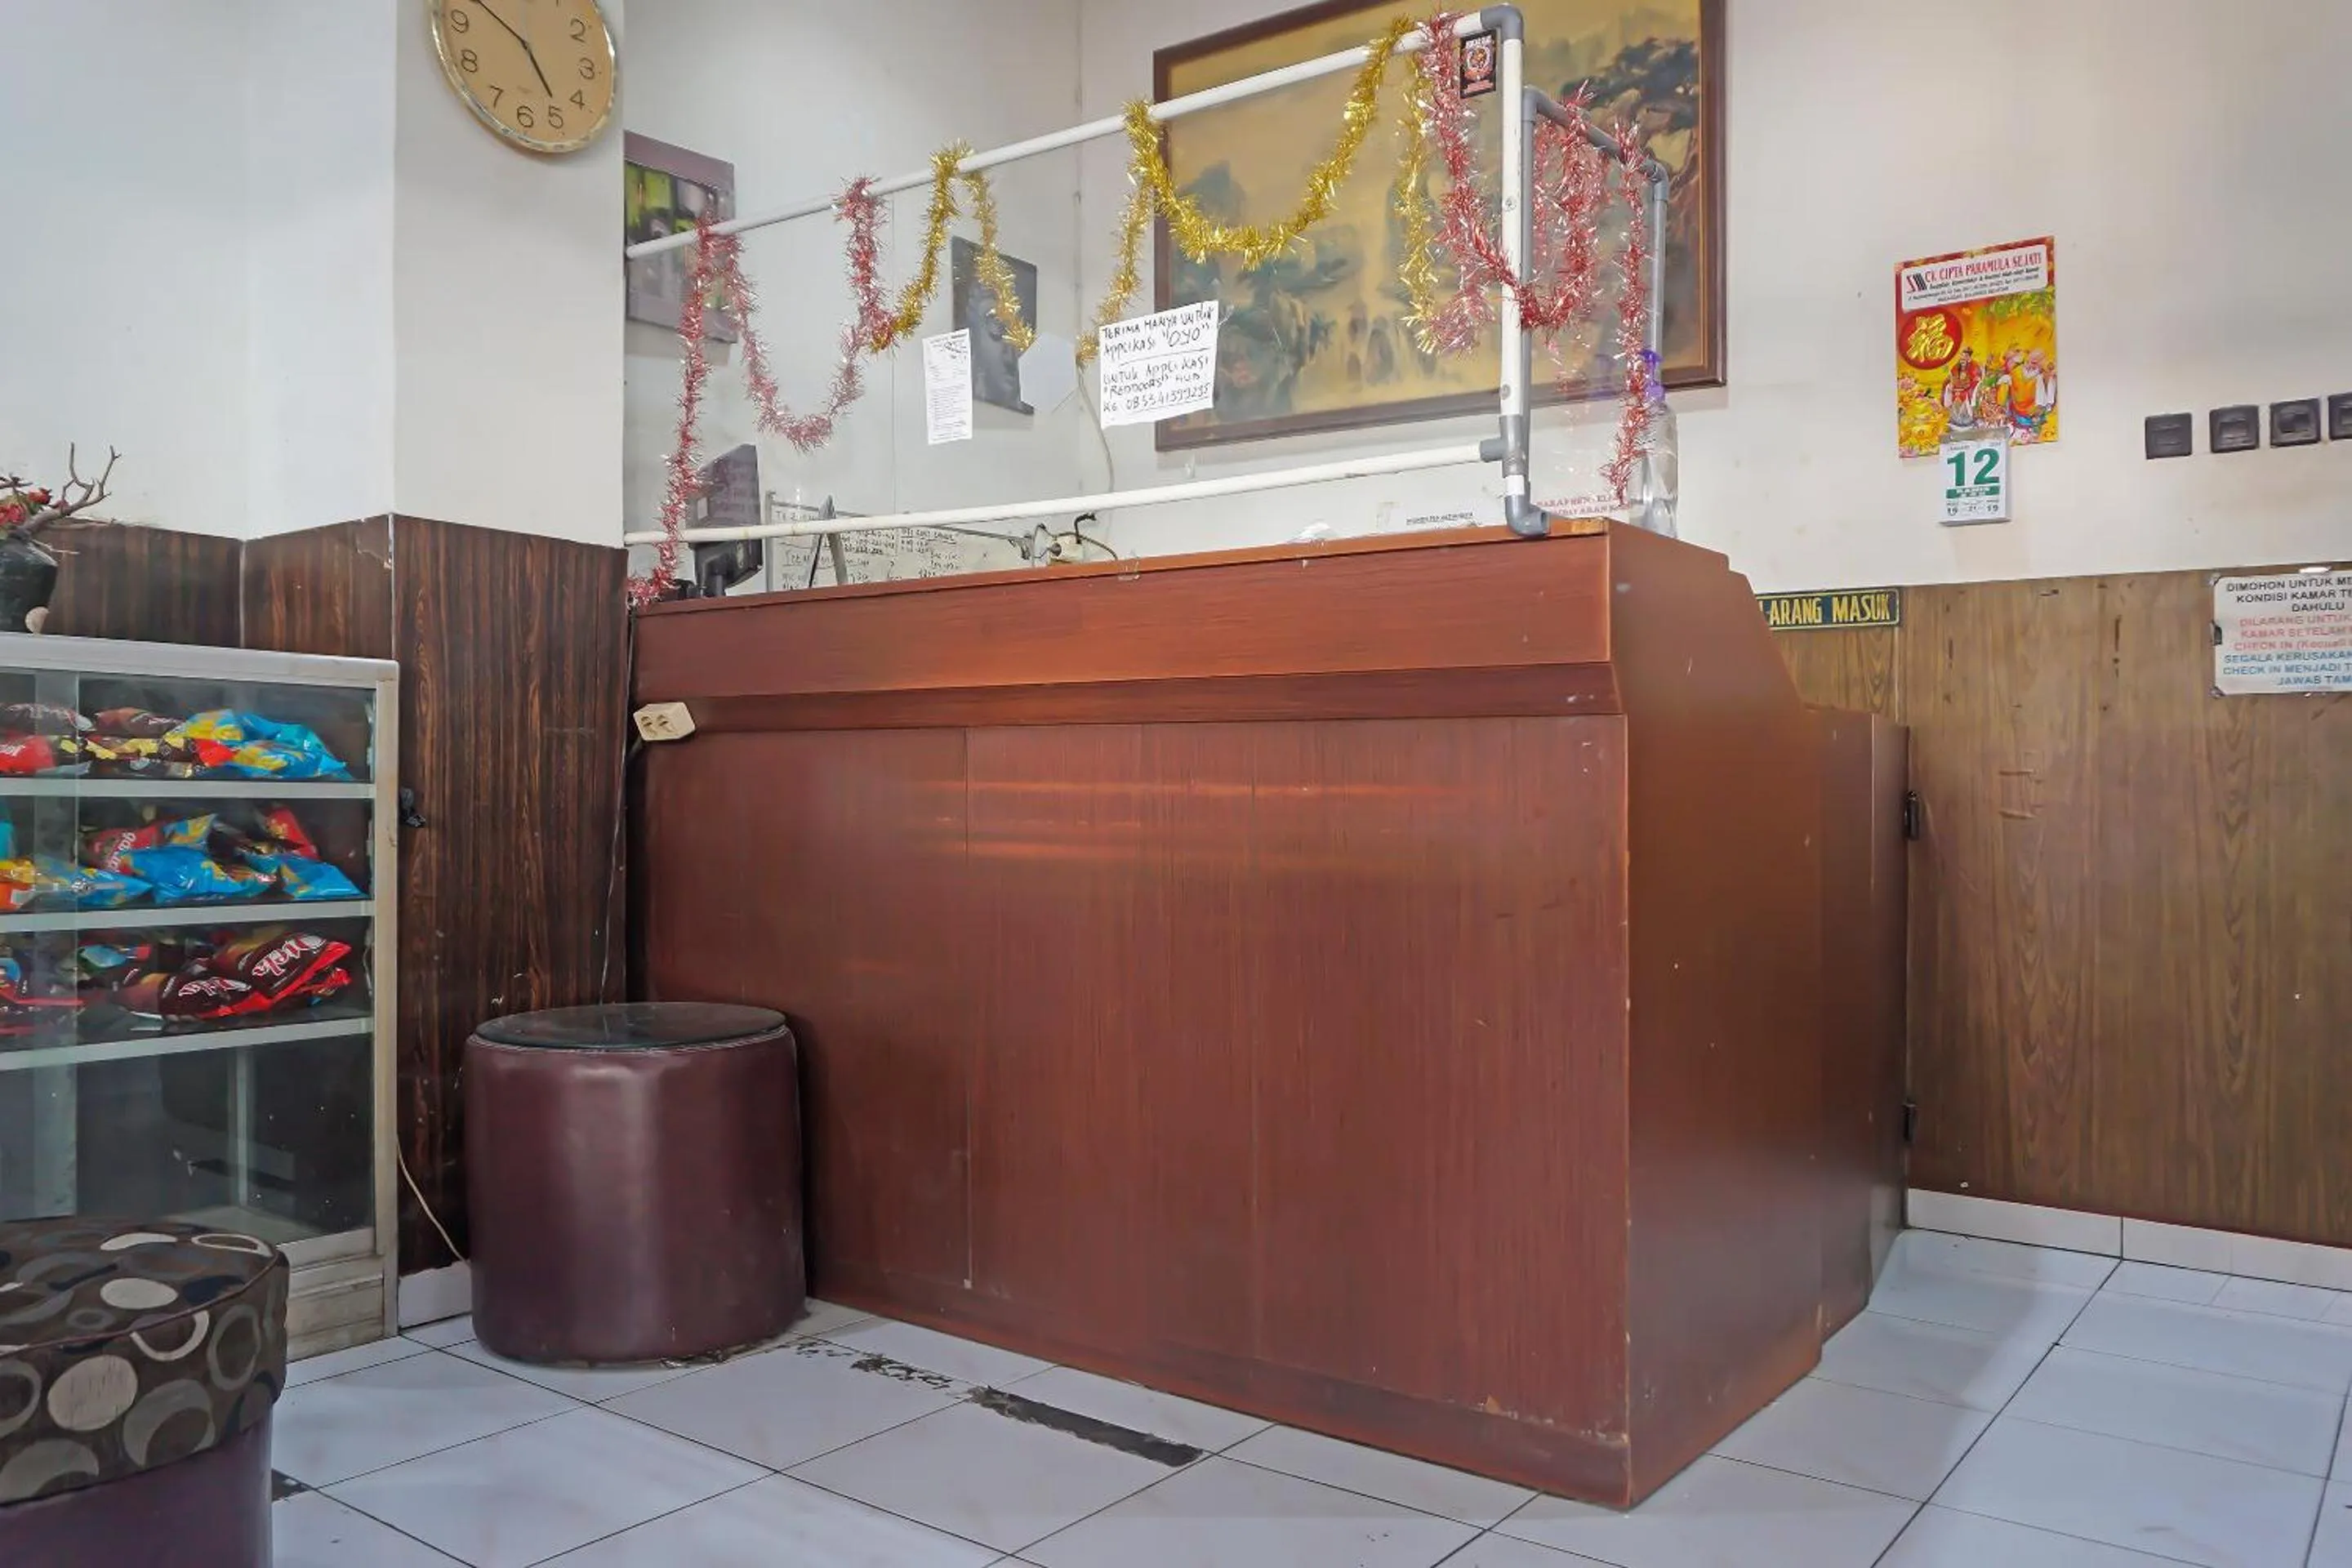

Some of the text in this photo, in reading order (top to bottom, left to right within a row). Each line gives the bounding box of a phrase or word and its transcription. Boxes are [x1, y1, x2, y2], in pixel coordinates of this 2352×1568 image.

[451, 9, 470, 33] 9
[570, 18, 586, 42] 2
[461, 49, 478, 73] 8
[579, 57, 595, 80] 3
[490, 85, 504, 109] 7
[569, 89, 586, 110] 4
[517, 105, 534, 128] 6
[548, 105, 564, 129] 5
[1907, 314, 1954, 363] 福
[1947, 448, 2000, 487] 12
[2226, 581, 2285, 591] DIMOHON
[2289, 578, 2332, 588] UNTUK
[2237, 592, 2287, 603] KONDISI
[2292, 589, 2336, 599] KAMAR
[1833, 594, 1891, 623] MASUK
[2292, 601, 2345, 612] DAHULU
[2223, 666, 2265, 675] CHECK
[2285, 662, 2341, 673] MENJADI
[2225, 654, 2273, 663] SEGALA
[2278, 675, 2321, 685] JAWAB
